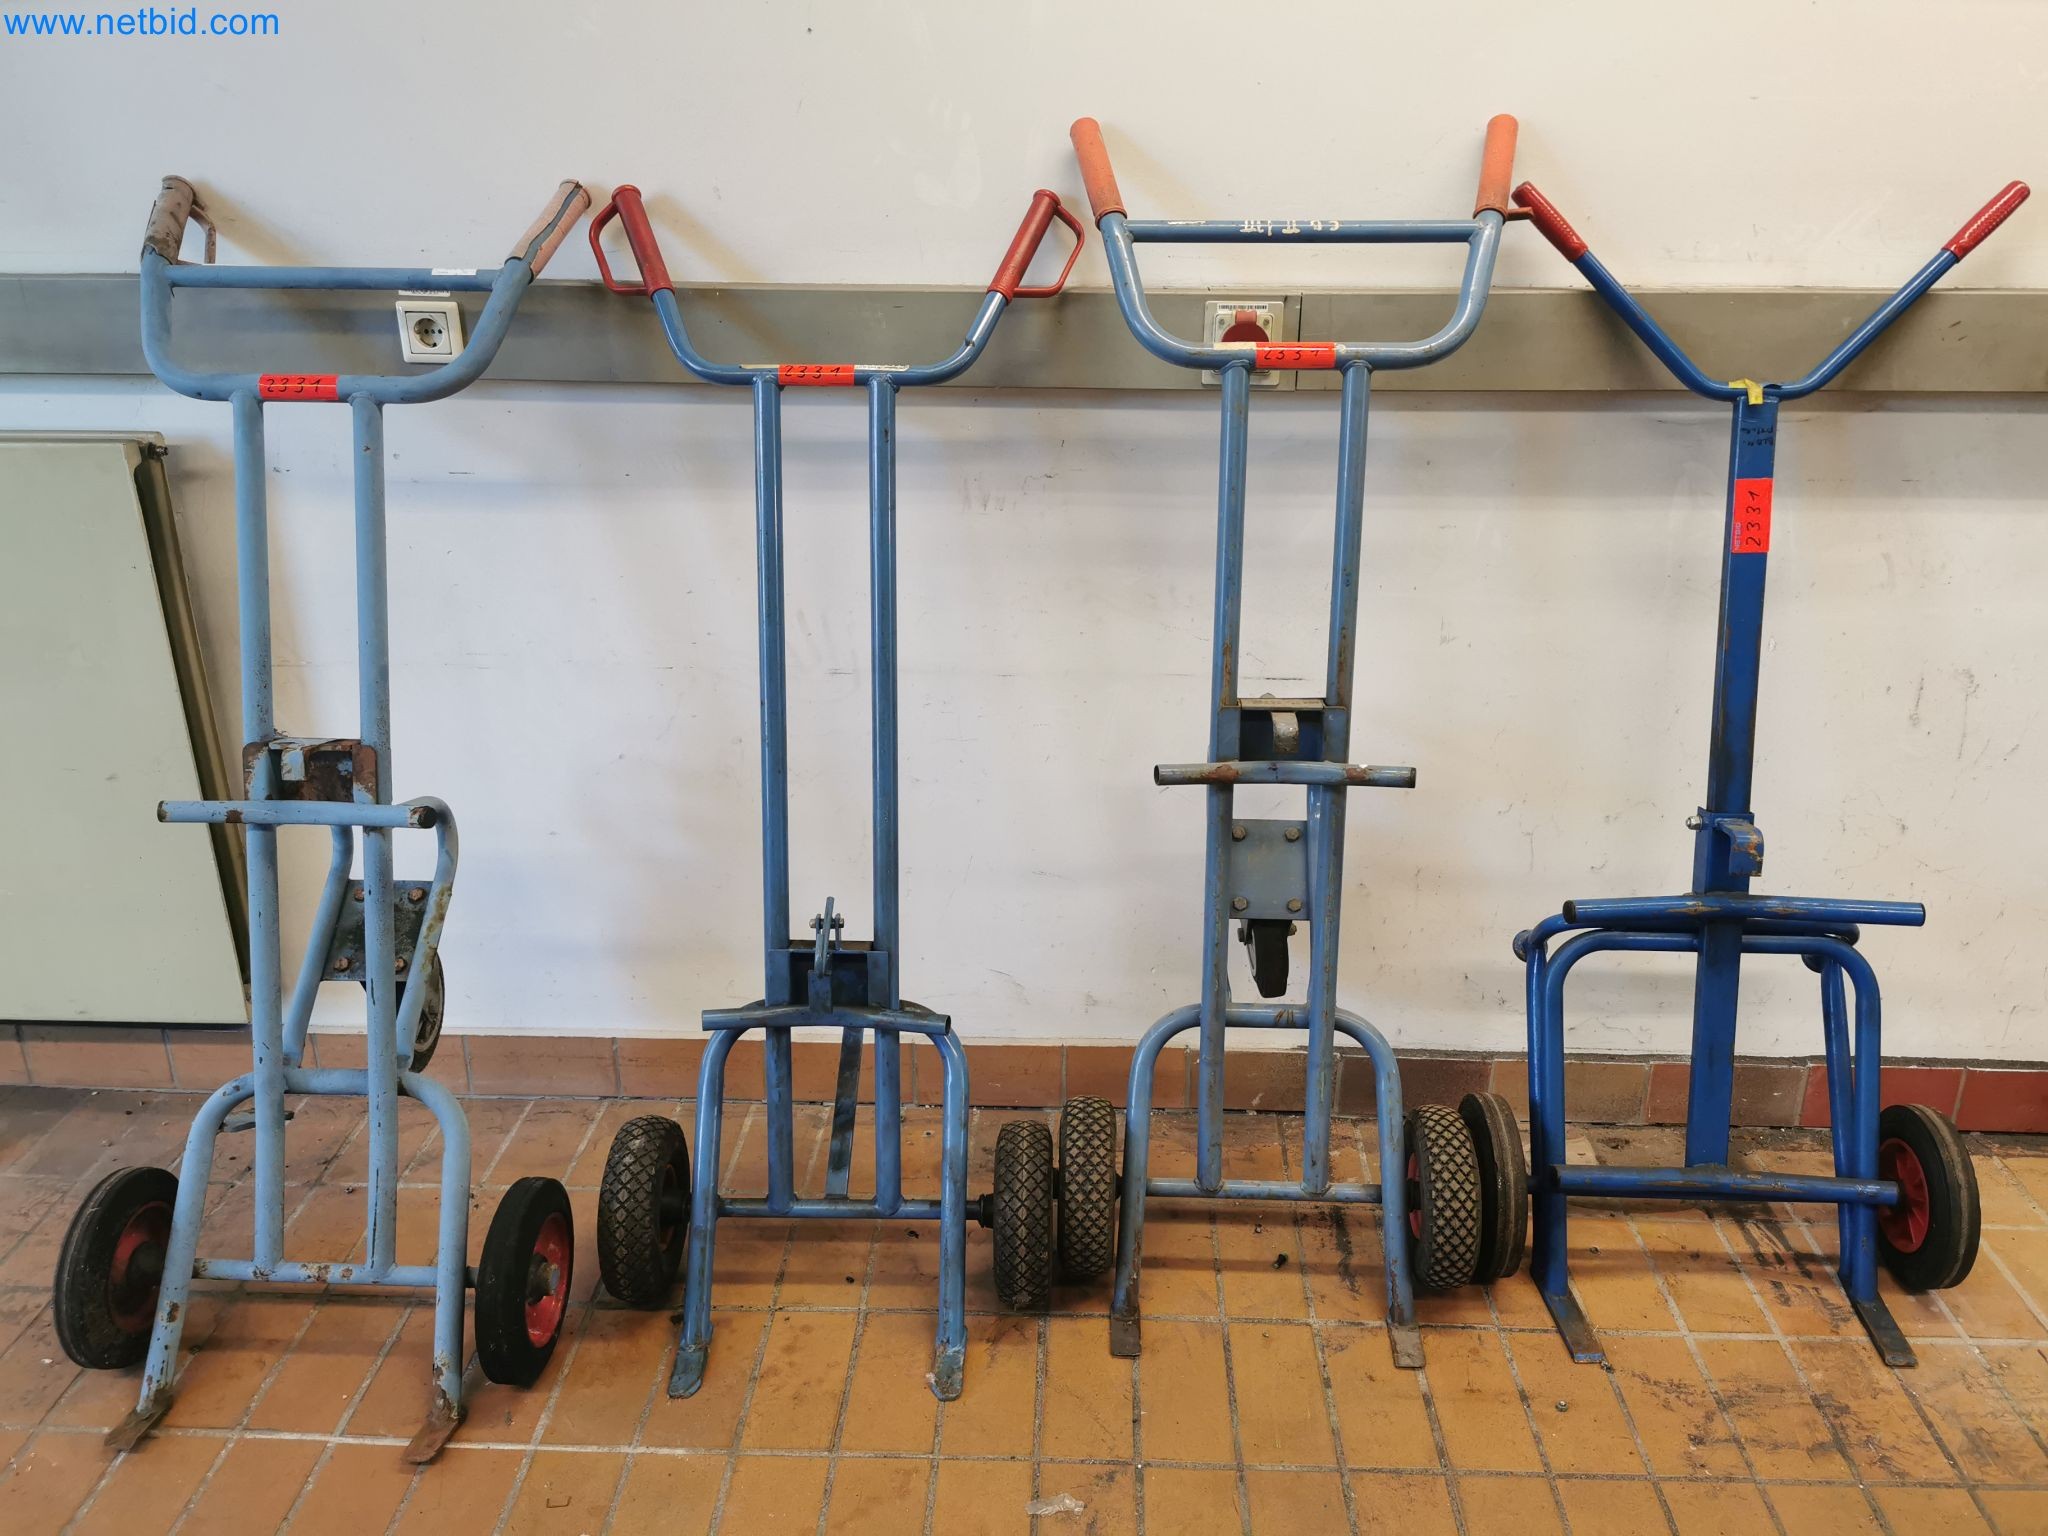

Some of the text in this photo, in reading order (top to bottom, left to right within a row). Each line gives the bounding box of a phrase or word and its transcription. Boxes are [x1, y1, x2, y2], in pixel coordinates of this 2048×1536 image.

[1263, 345, 1321, 361] 2331
[784, 364, 841, 379] 2331
[266, 376, 322, 394] 2331
[1745, 490, 1761, 547] 2331
